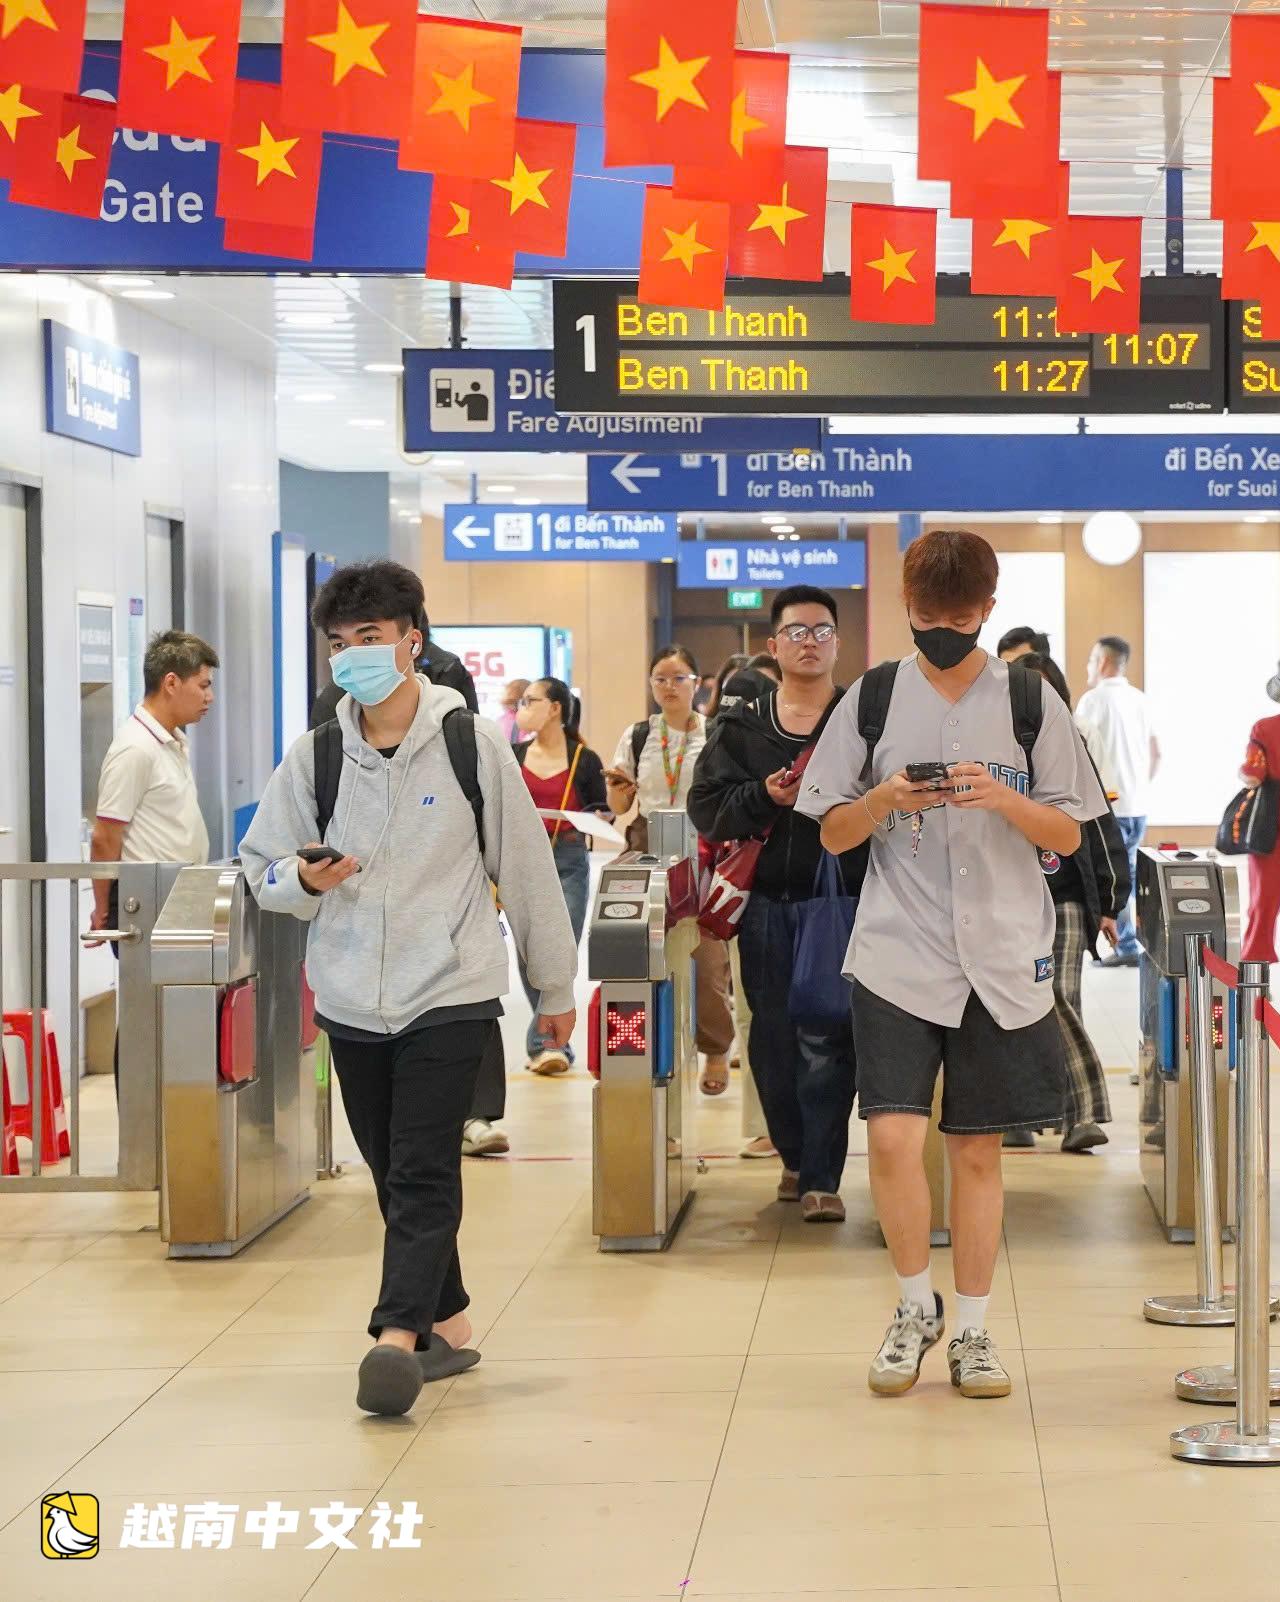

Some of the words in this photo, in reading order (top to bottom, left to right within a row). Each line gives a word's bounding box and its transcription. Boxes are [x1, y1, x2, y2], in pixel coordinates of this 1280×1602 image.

[100, 178, 204, 223] Gate
[617, 304, 688, 336] Ben
[575, 314, 597, 373] 1
[1103, 333, 1199, 365] 11:07
[618, 358, 689, 390] Ben
[700, 359, 808, 391] Thanh
[993, 360, 1089, 392] 11:27
[507, 410, 559, 433] Fare
[566, 415, 704, 438] Adjustment
[711, 453, 728, 497] 1
[832, 447, 913, 472] Thành
[1164, 446, 1187, 471] đi
[1195, 443, 1243, 471] Bến
[746, 479, 772, 497] for
[778, 480, 813, 497] Ben
[818, 480, 875, 498] Thanh
[1208, 478, 1233, 497] for
[1237, 478, 1278, 497] Suoi
[536, 512, 552, 552] 1
[574, 512, 609, 533] Bến
[611, 514, 666, 533] Thành
[464, 651, 505, 677] 5G
